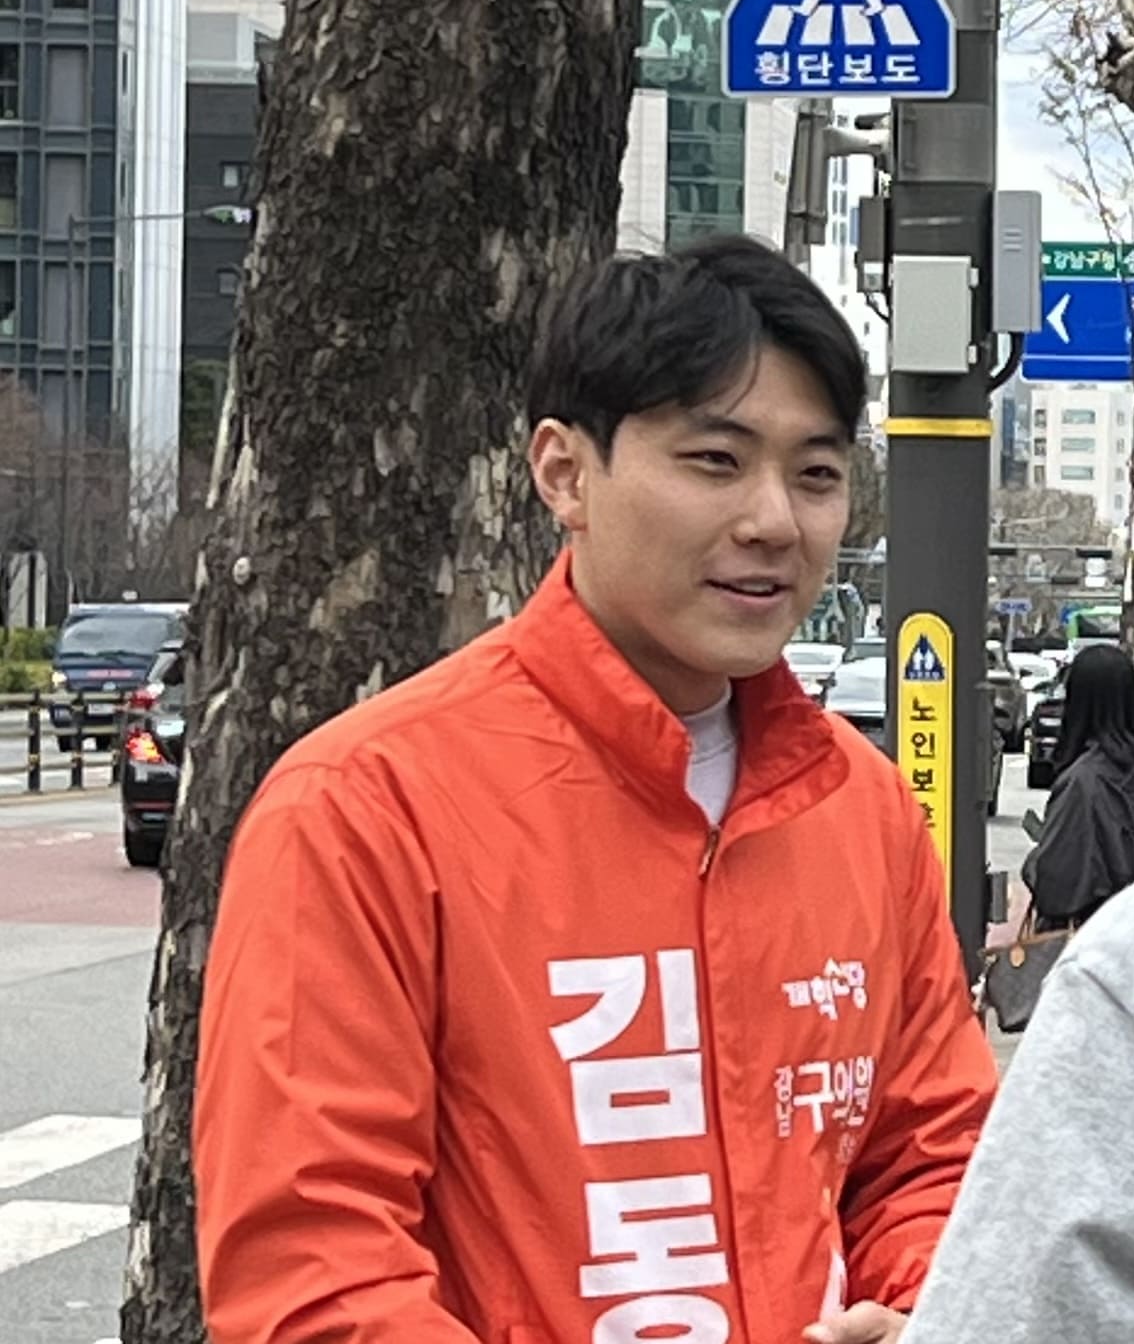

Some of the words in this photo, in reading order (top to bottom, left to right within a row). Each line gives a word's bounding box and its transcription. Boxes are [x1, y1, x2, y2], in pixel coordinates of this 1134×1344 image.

[754, 50, 921, 86] 횡단보도
[1053, 250, 1116, 272] 강남구청
[781, 957, 868, 1020] 개혁신당
